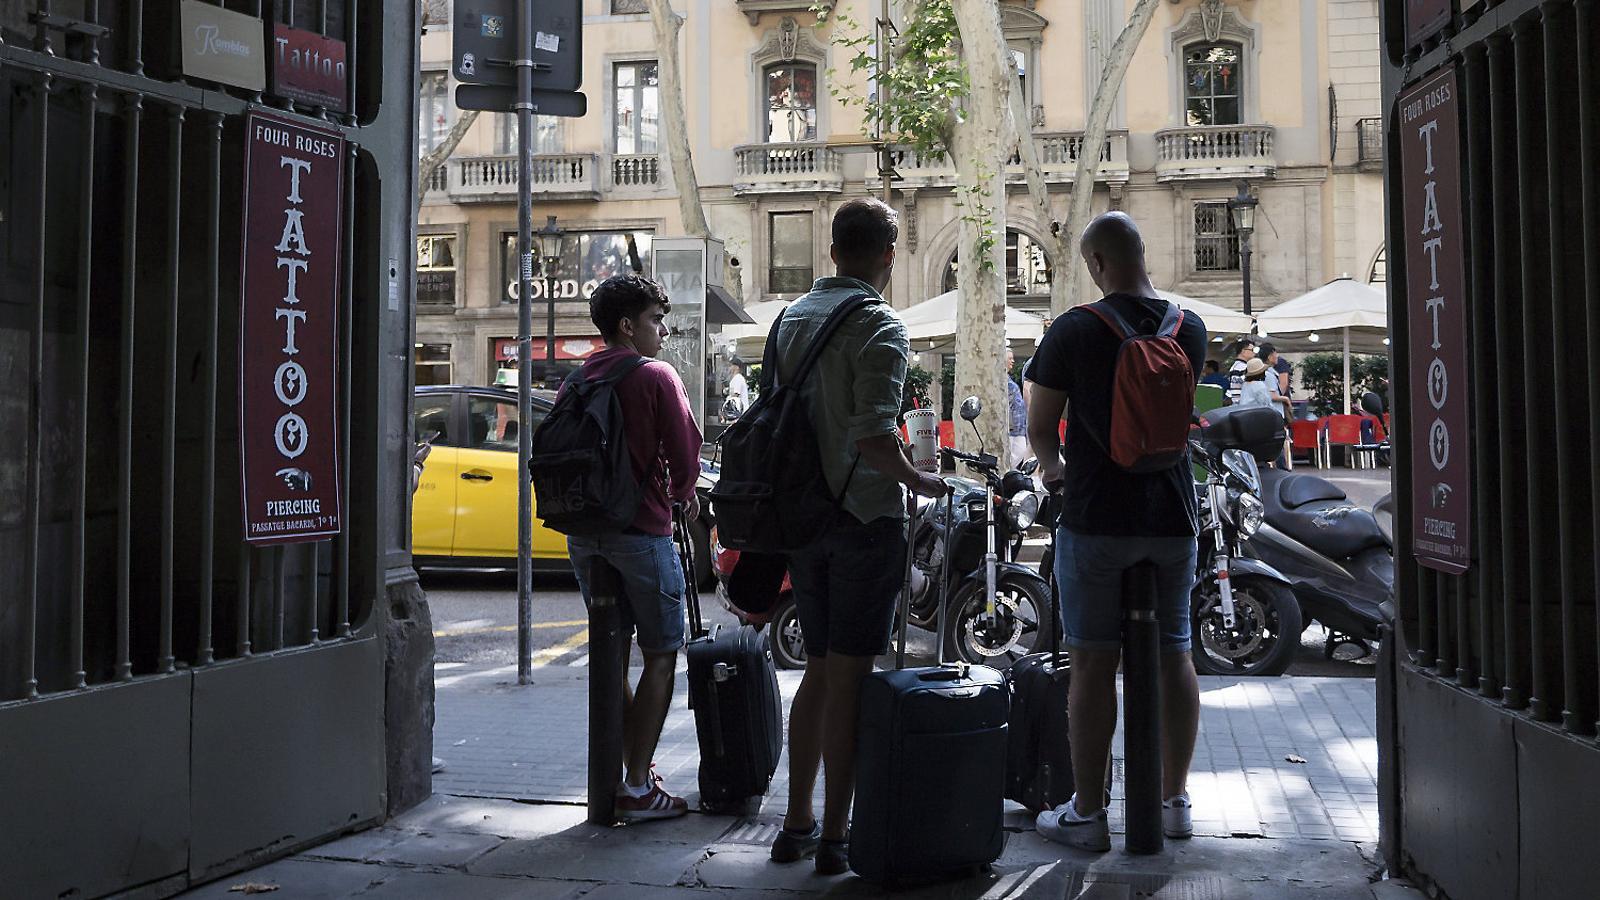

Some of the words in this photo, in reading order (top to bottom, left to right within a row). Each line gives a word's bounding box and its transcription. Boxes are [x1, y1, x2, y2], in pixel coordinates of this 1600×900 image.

[276, 37, 345, 80] Tattoo
[1403, 99, 1423, 124] FOUR
[1425, 83, 1451, 111] ROSES
[256, 125, 290, 148] FOUR
[295, 135, 336, 158] ROSES
[274, 155, 312, 459] TATTOO
[1418, 119, 1450, 471] TATTOO
[266, 499, 321, 516] PIERCING
[252, 522, 285, 533] PASSATGE
[1424, 517, 1456, 539] PIERCING
